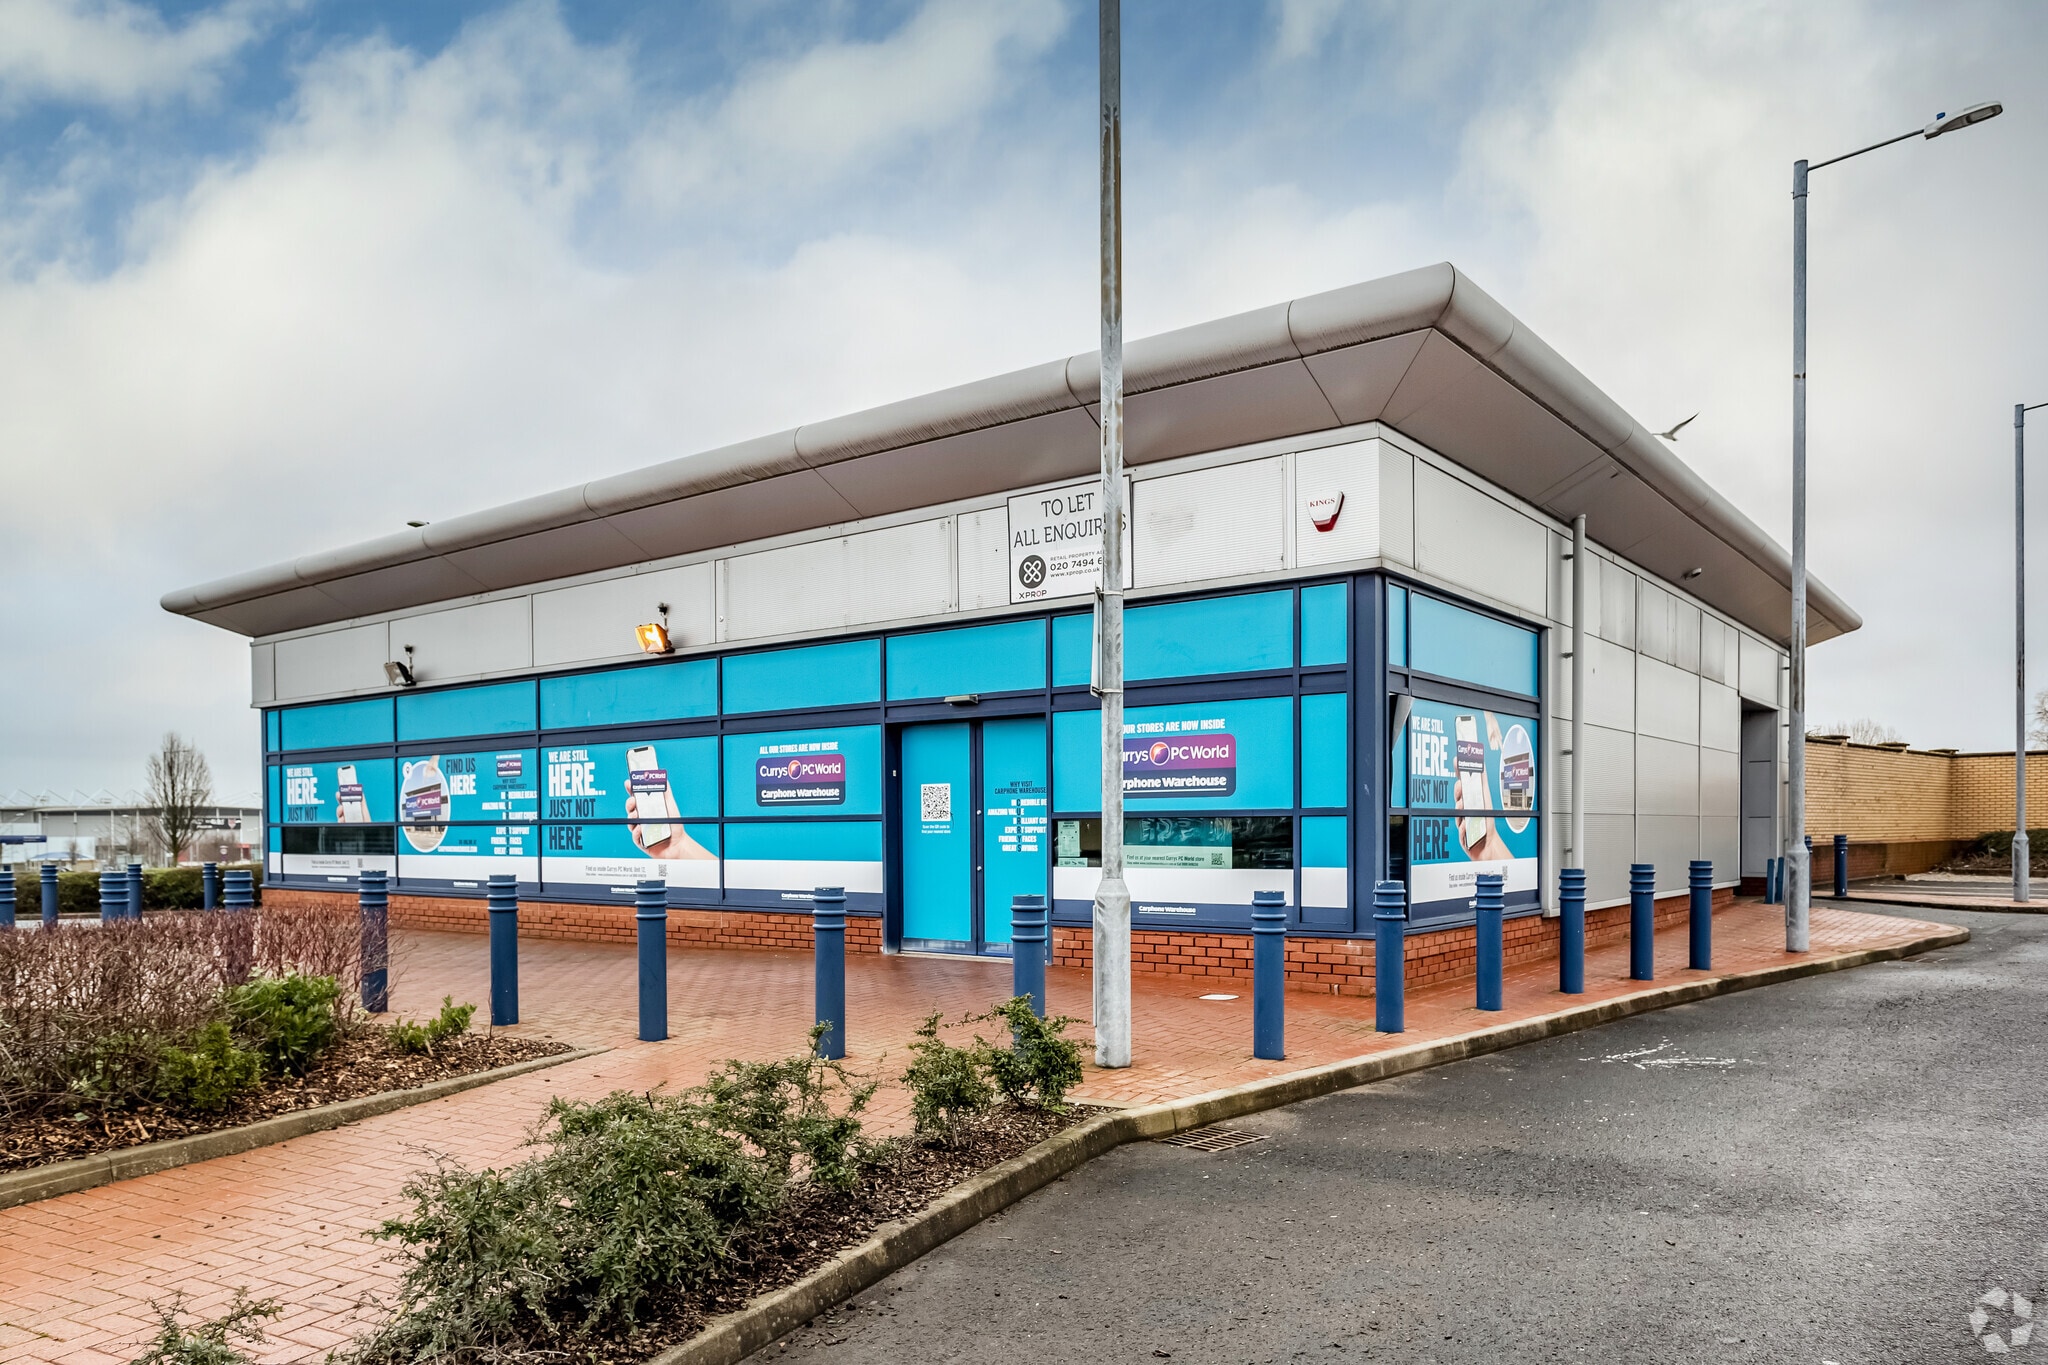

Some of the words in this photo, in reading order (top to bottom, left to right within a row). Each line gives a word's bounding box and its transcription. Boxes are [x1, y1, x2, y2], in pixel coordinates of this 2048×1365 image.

[1041, 499, 1063, 517] TO
[1068, 492, 1094, 513] LET
[1310, 497, 1336, 507] KINGS
[1014, 529, 1040, 548] ALL
[1069, 551, 1095, 559] PROPERTY
[1050, 562, 1069, 571] 020
[1071, 558, 1094, 569] 7494
[1050, 567, 1100, 578] www.xprop.co.uk
[1018, 589, 1047, 600] XPROP
[1123, 724, 1135, 734] OUR
[1137, 722, 1164, 733] STORES
[1165, 721, 1180, 731] ARE
[1181, 720, 1198, 731] NOW
[1200, 718, 1225, 730] INSIDE
[1412, 716, 1421, 731] WE
[1421, 718, 1430, 732] ARE
[1431, 719, 1444, 734] STILL
[548, 752, 558, 763] WE
[559, 751, 571, 762] ARE
[572, 749, 589, 761] STILL
[760, 746, 768, 754] ALL
[780, 744, 797, 753] STORES
[798, 744, 808, 752] ARE
[822, 742, 838, 750] INSIDE
[1171, 746, 1189, 760] PC
[1190, 744, 1229, 759] World
[446, 759, 464, 774] FIND
[466, 757, 476, 773] US
[760, 765, 788, 778] Currys
[802, 764, 814, 775] PC
[815, 762, 841, 774] World
[450, 774, 476, 795] HERE
[1123, 777, 1161, 790] rphone
[1162, 775, 1227, 788] Warehouse
[761, 789, 796, 799] Carphone
[796, 787, 840, 797] Warehouse
[1412, 779, 1431, 803] JUST
[1433, 780, 1448, 804] NOT
[288, 806, 303, 822] JUST
[305, 806, 318, 822] NOT
[549, 799, 572, 818] JUST
[576, 798, 596, 817] NOT
[549, 826, 583, 850] HERE
[1413, 819, 1449, 860] HERE
